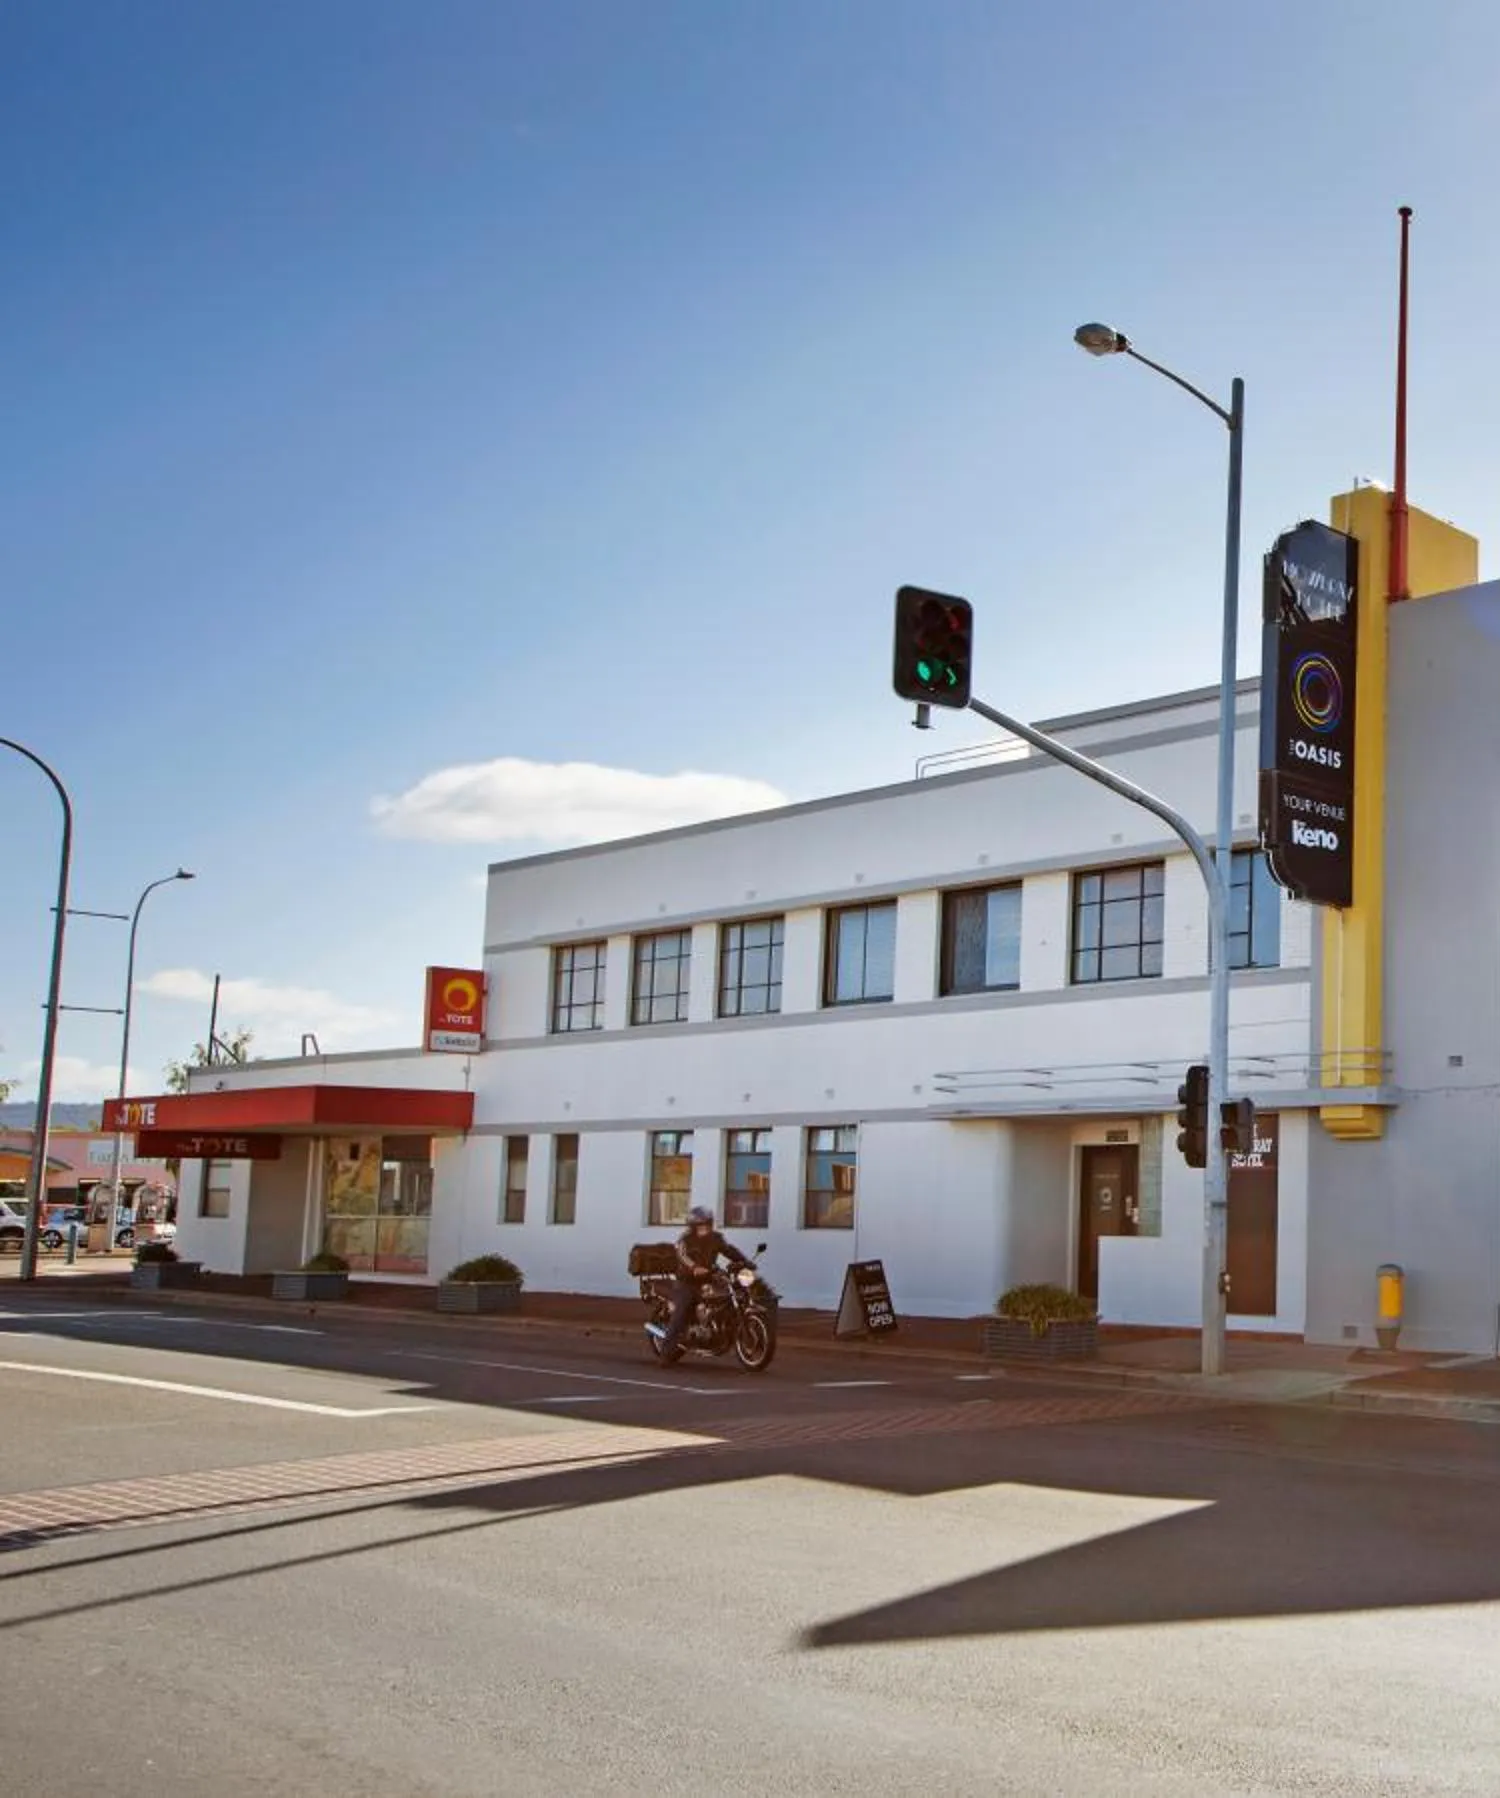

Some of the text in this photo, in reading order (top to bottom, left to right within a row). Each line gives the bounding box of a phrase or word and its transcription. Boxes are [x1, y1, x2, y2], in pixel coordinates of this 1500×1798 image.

[1295, 740, 1341, 769] OASIS
[1283, 794, 1344, 820] YOUR VENUE
[446, 1013, 473, 1025] TOTE
